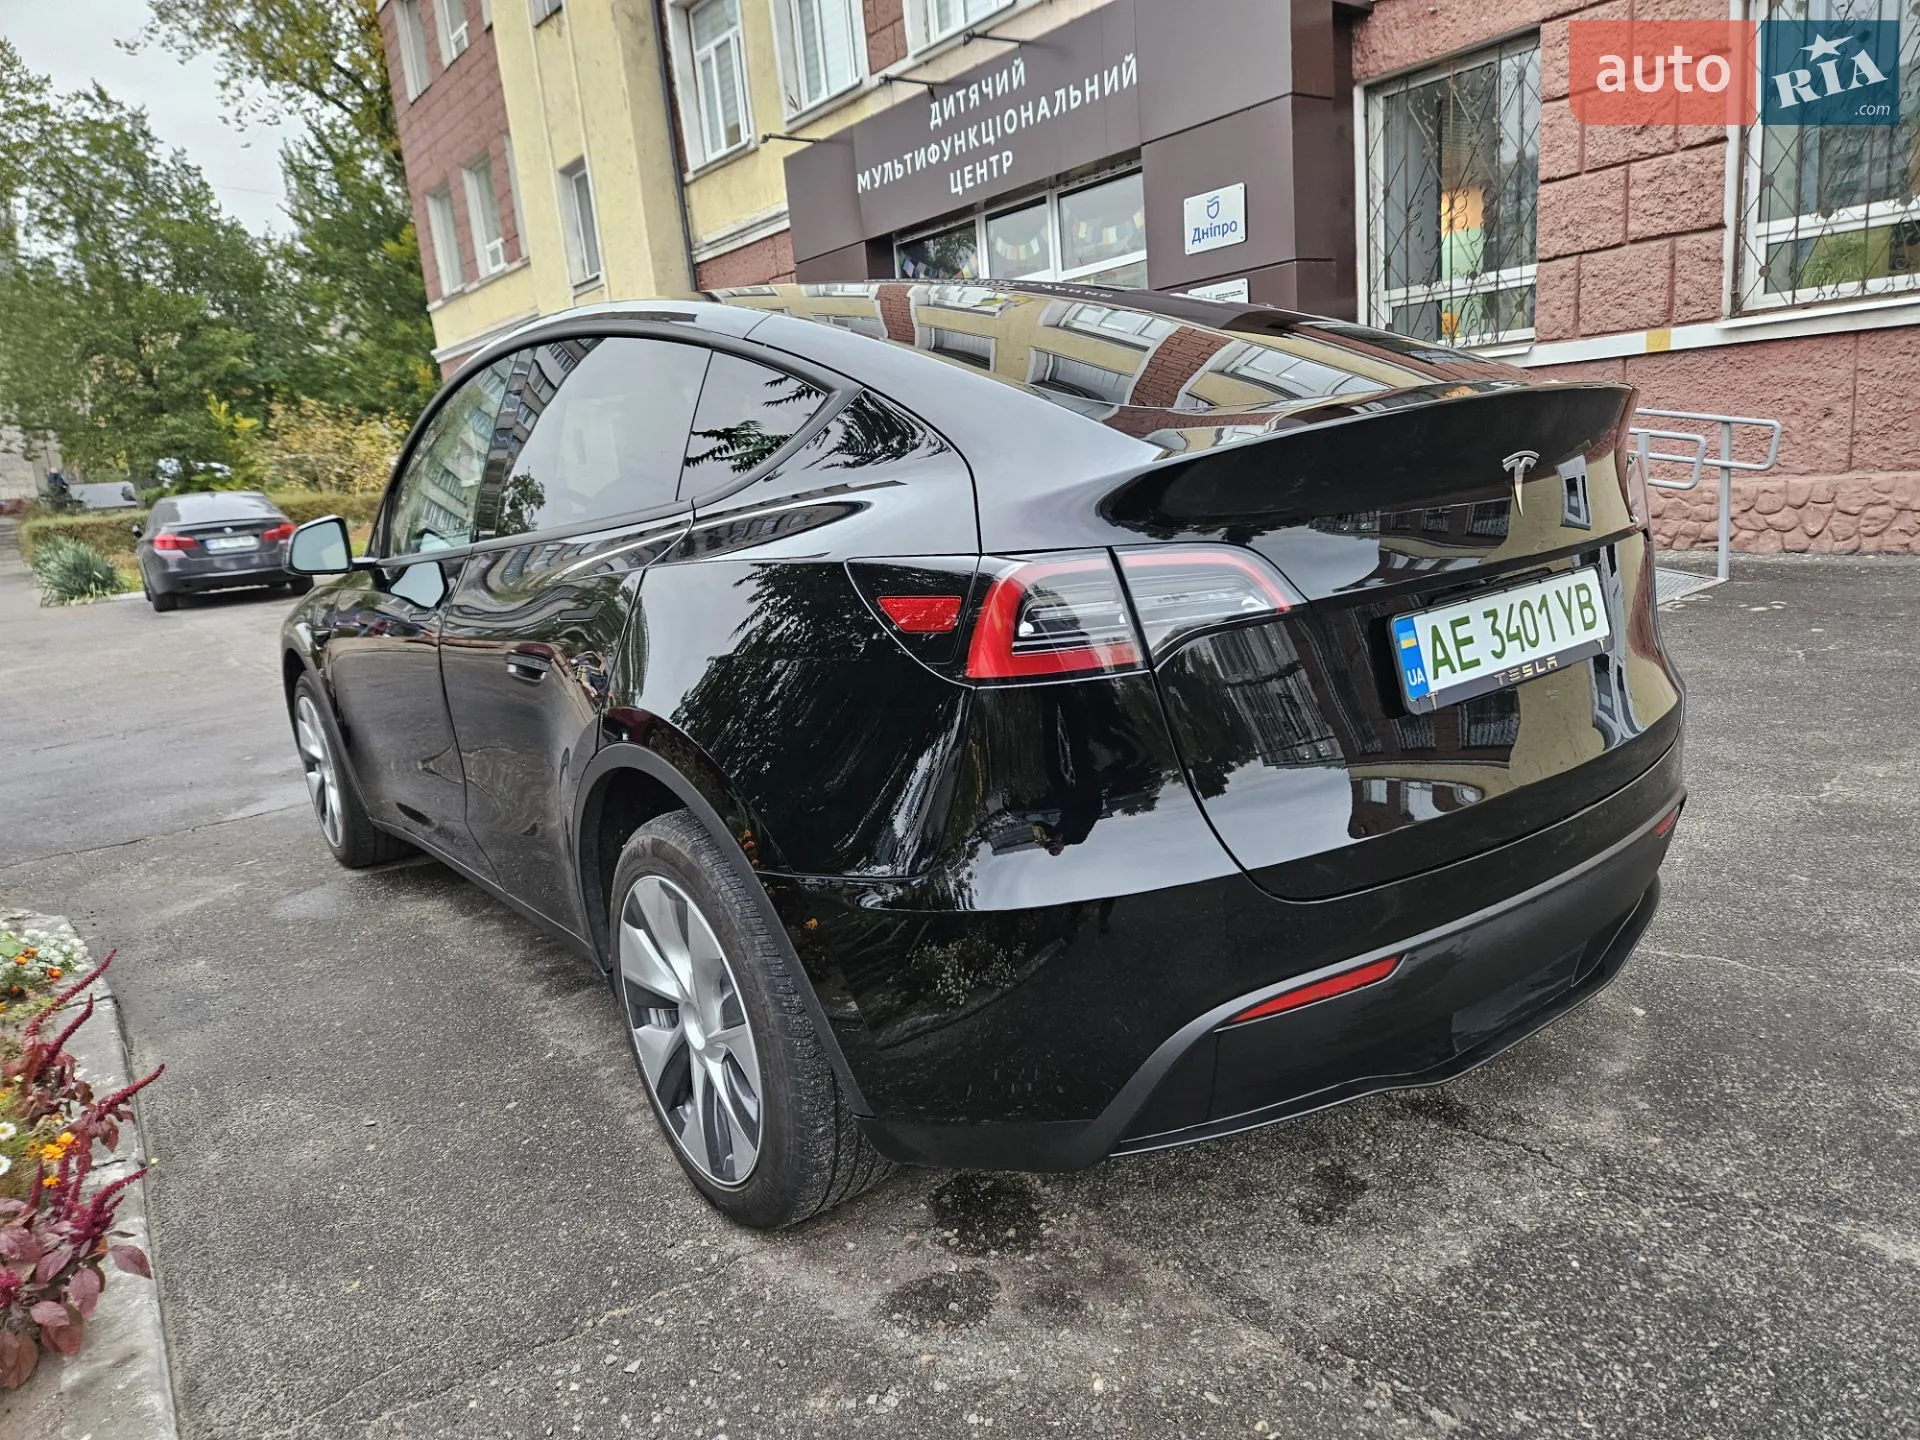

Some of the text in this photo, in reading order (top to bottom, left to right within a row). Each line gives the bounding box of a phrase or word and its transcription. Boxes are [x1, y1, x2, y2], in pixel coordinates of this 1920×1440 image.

[929, 57, 1026, 131] ДИТЯЧИЙ
[856, 52, 1138, 194] МУЛЬТИФУНКЦІОНАЛЬНИЙ
[949, 150, 1014, 196] ЦЕНТР
[1191, 220, 1238, 245] Дніпро
[1430, 582, 1598, 680] AE 3401 YB
[1407, 669, 1426, 687] UA
[1493, 655, 1558, 686] TESLA
